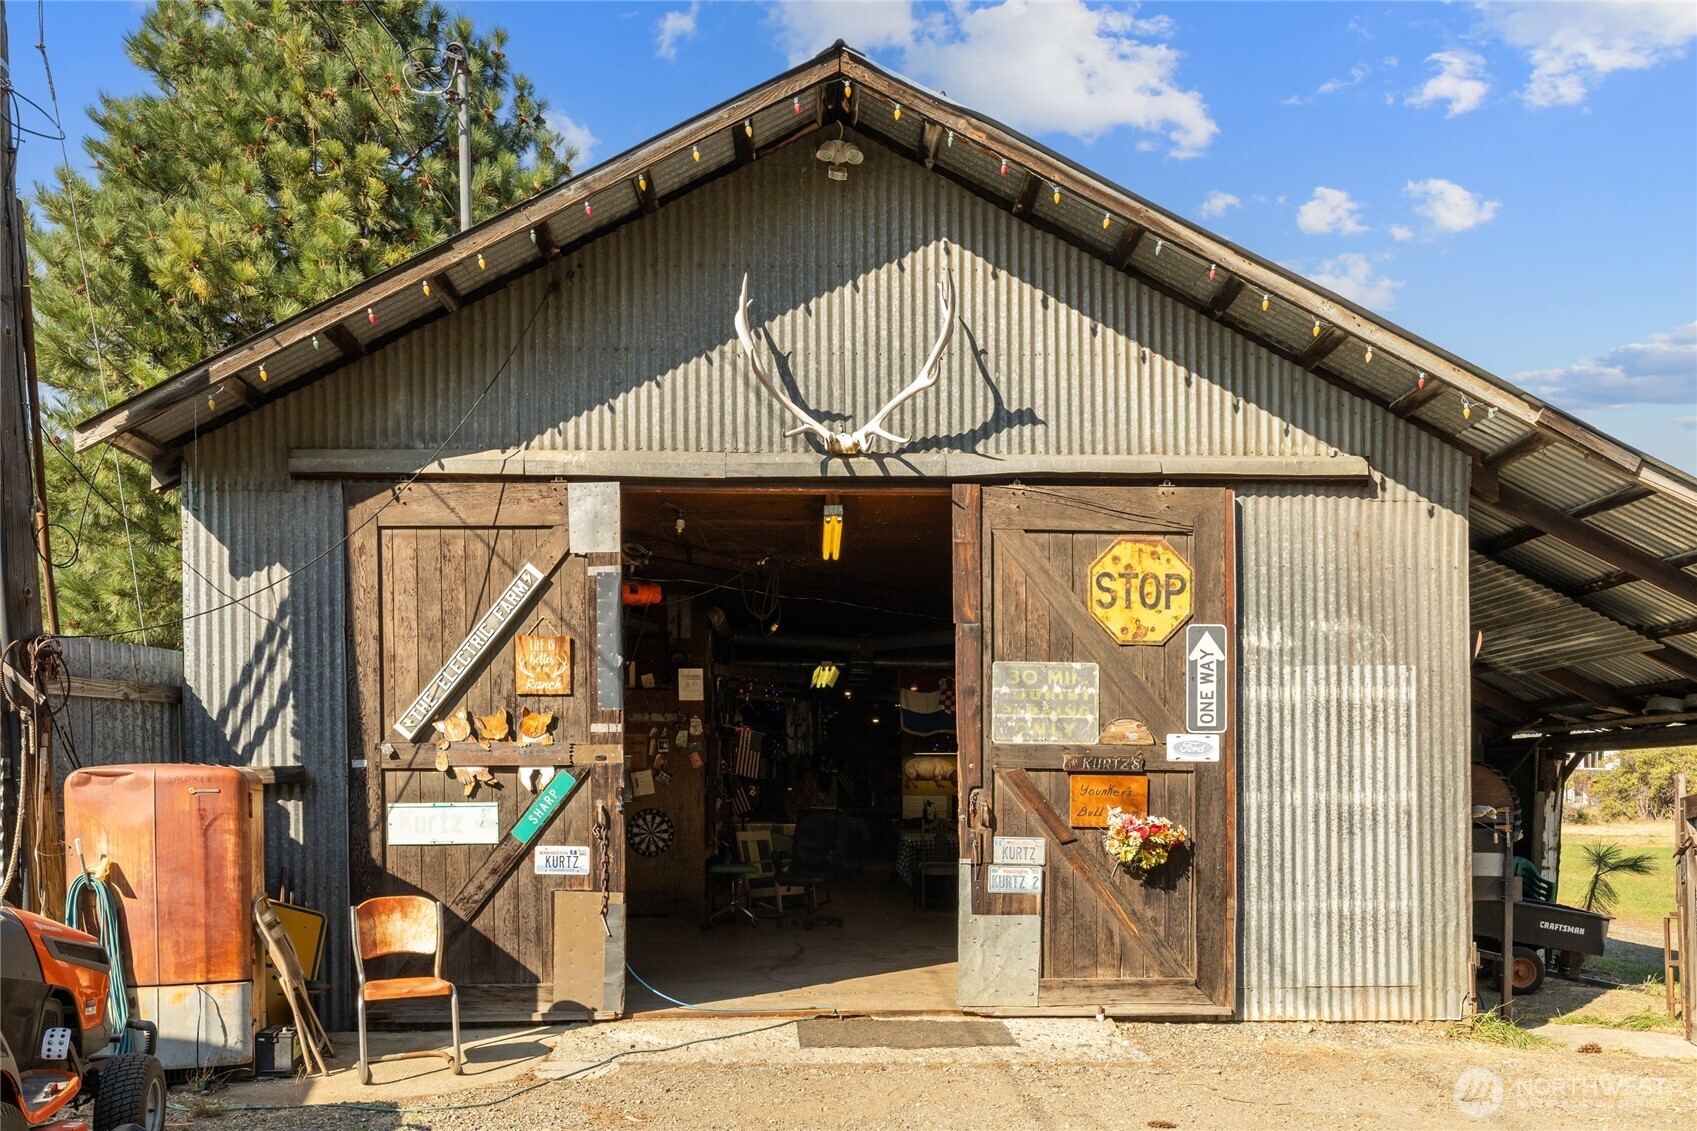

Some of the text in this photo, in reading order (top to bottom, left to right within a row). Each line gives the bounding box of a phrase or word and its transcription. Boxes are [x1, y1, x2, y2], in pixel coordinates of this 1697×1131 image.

[1095, 571, 1187, 610] STOP
[410, 581, 529, 721] THE ELECTRIC FARM
[530, 639, 555, 651] LIFE IS
[530, 651, 555, 666] better
[526, 677, 563, 690] Ranch
[1007, 669, 1037, 685] 30
[1199, 648, 1214, 724] ONE WAY
[1180, 741, 1207, 753] Ford
[1082, 756, 1140, 770] KURTZ'S
[167, 775, 212, 784] SMOKER
[528, 788, 558, 824] SHARP
[398, 809, 464, 834] Kurtz
[1001, 846, 1036, 860] KURTZ
[545, 855, 579, 869] KURTZ
[991, 875, 1039, 889] KURTZ 2
[1540, 921, 1585, 935] CRAFTSMAN
